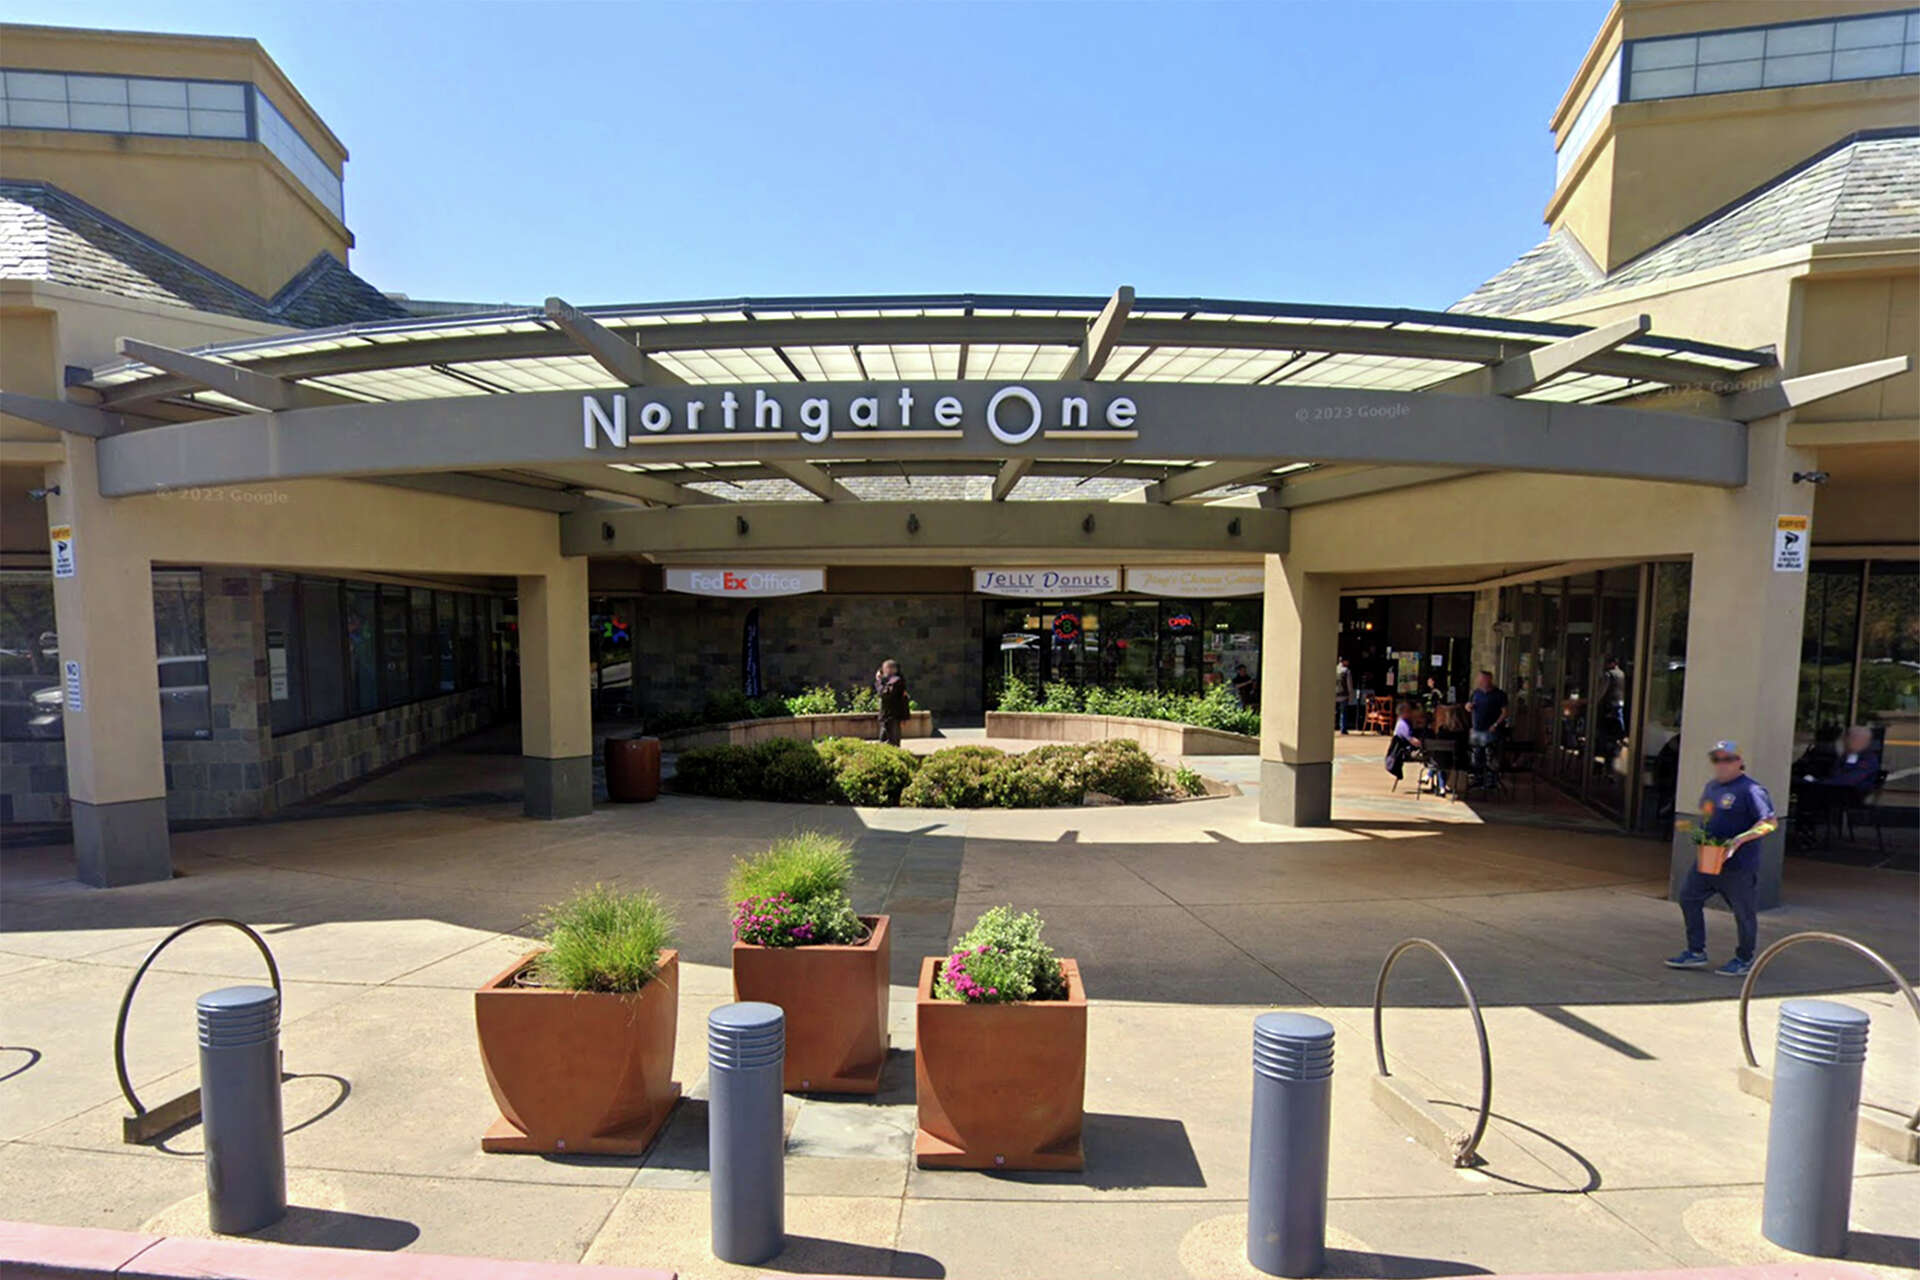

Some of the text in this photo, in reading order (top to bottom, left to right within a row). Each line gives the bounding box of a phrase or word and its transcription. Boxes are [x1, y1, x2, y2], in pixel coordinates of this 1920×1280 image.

[583, 386, 1138, 449] Northgate One
[691, 572, 800, 590] FedEx Office
